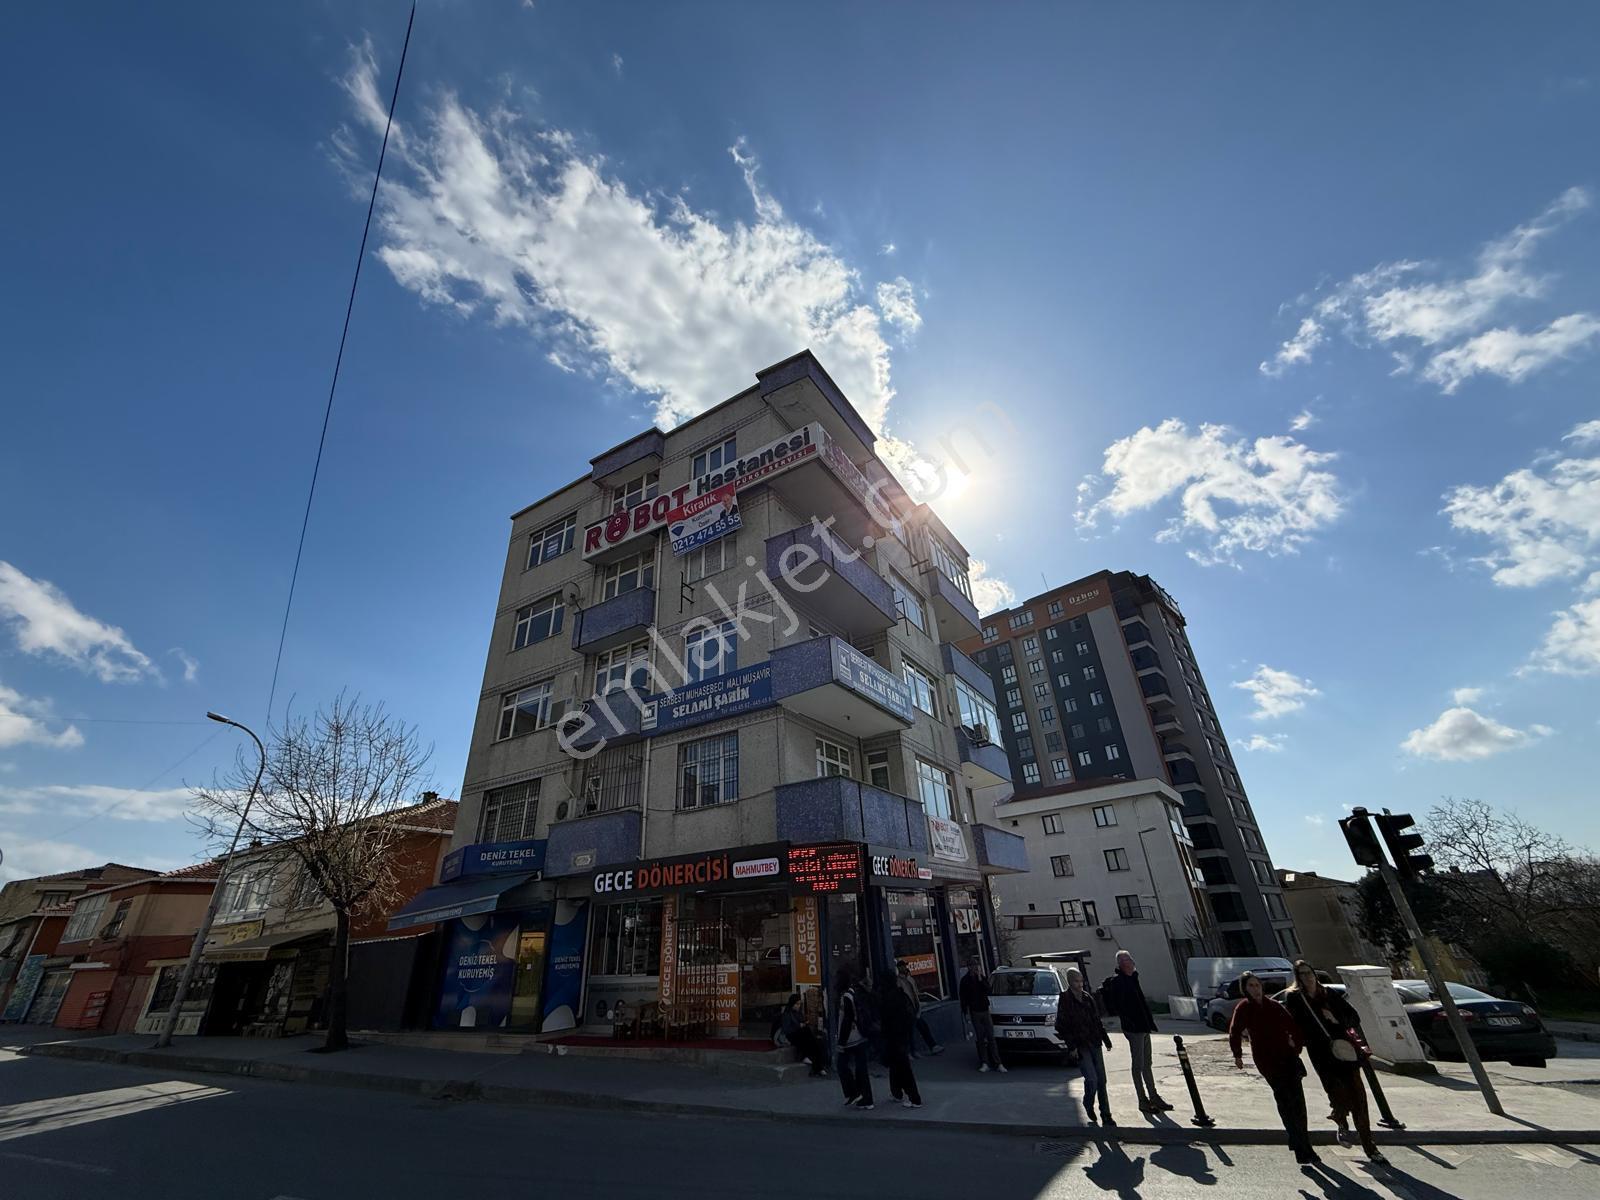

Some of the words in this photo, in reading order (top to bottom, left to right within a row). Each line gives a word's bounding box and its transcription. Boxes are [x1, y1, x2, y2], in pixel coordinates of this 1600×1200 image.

[585, 484, 690, 552] ROBOT
[697, 427, 810, 495] Hastanesi
[683, 493, 717, 517] Kiralık
[673, 535, 695, 552] 0212
[697, 526, 714, 540] 474
[716, 518, 727, 532] 55
[728, 512, 741, 525] 55
[660, 691, 685, 708] SERBEST
[672, 695, 713, 719] SELAMİ
[480, 849, 507, 861] DENİZ
[508, 848, 536, 858] TEKEL
[873, 855, 889, 876] GECE
[594, 870, 633, 893] GECE
[638, 853, 729, 890] DÖNERCİSİ
[735, 862, 777, 876] MAHMUTBEY
[797, 914, 807, 955] GECE
[806, 896, 817, 976] DÖNERCİS
[458, 954, 478, 966] DENİZ
[478, 955, 497, 965] TEKEL
[458, 965, 495, 980] KURUYEMİŞ
[662, 967, 672, 996] GECE
